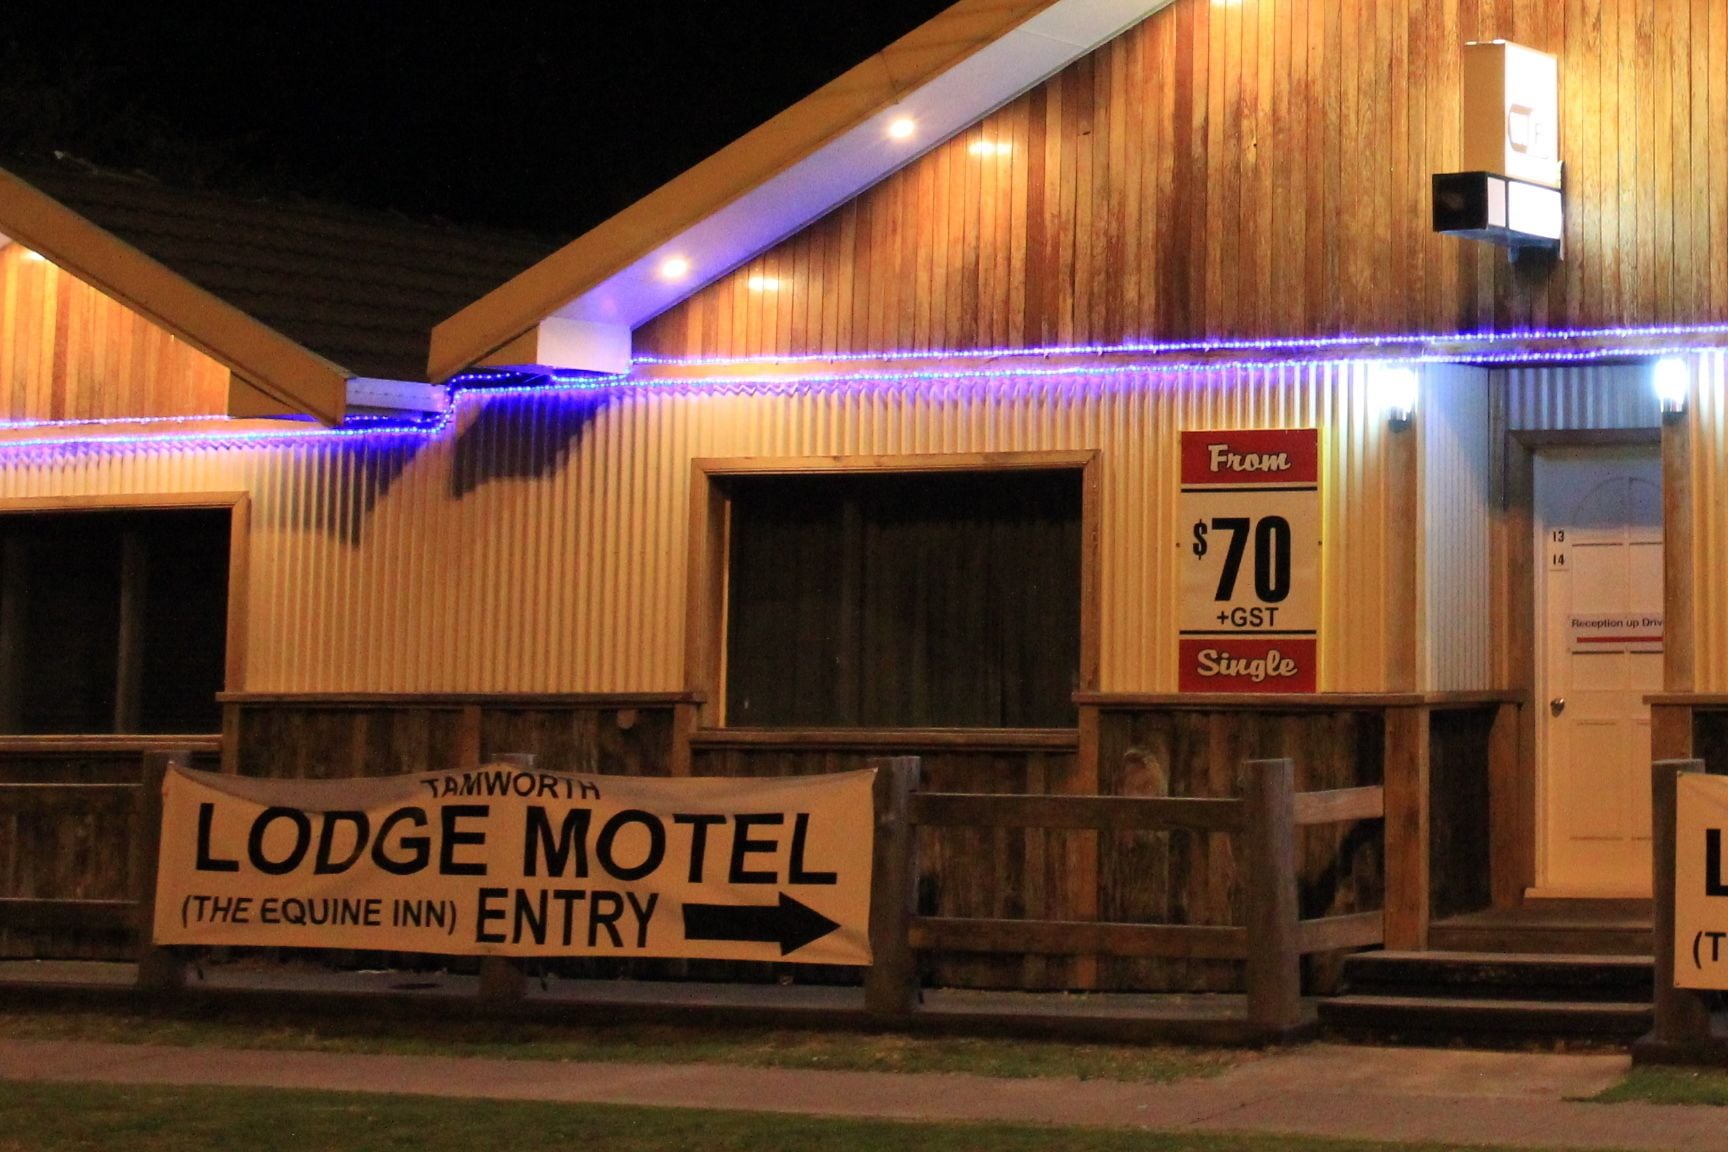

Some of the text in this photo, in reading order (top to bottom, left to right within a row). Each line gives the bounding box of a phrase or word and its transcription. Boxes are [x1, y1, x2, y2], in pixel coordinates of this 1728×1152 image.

[1207, 443, 1291, 473] From
[1552, 530, 1565, 543] 13
[1192, 515, 1291, 603] $70
[1552, 553, 1565, 566] 14
[1216, 607, 1279, 627] +GST
[1571, 618, 1623, 629] Reception
[1626, 619, 1640, 629] up
[1196, 649, 1298, 682] Single
[421, 771, 600, 800] TAMWORTH
[195, 802, 838, 885] LODGE MOTEL
[181, 894, 457, 935] (THE EQUINE INN)
[475, 887, 660, 948] ENTRY
